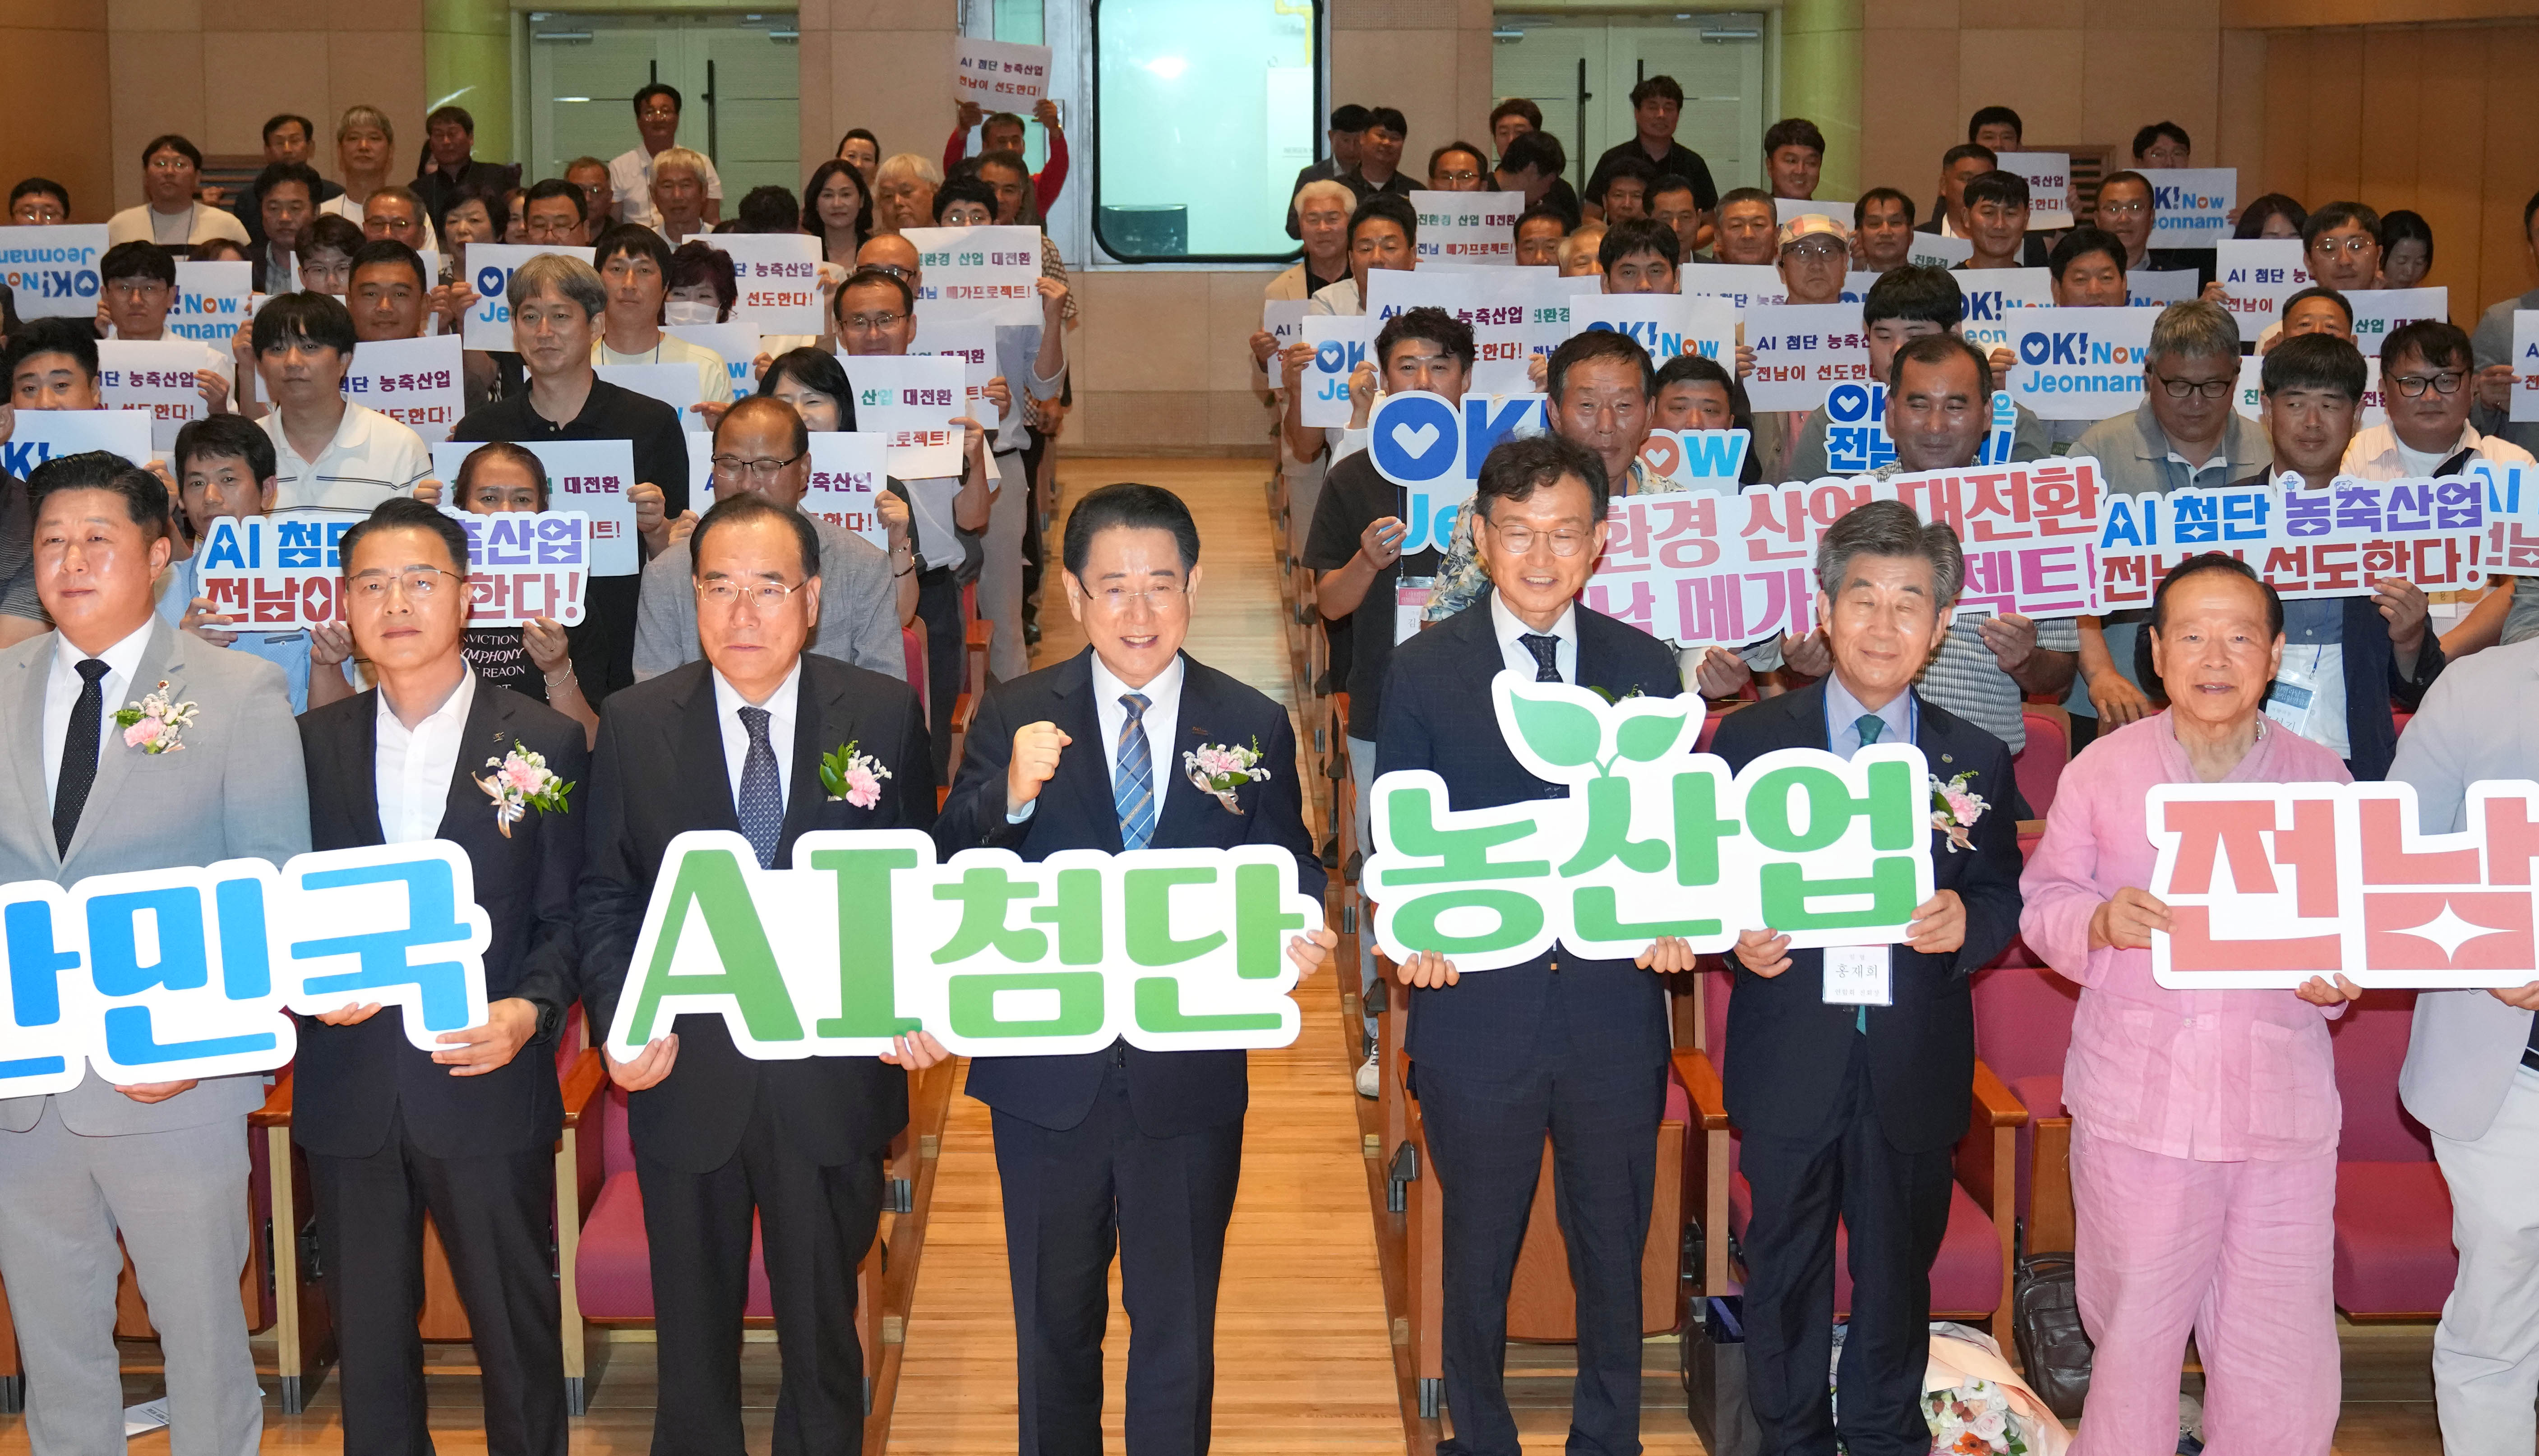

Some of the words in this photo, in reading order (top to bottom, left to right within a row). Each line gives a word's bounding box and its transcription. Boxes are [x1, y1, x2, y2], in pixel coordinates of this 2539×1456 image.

[960, 57, 972, 67] AI
[2182, 193, 2224, 209] Now
[1459, 215, 1479, 226] 산업
[1418, 243, 1439, 255] 전남
[958, 253, 983, 266] 산업
[992, 252, 1031, 266] 대전환
[756, 263, 812, 277] 농축산업
[2228, 269, 2246, 282] AI
[2255, 268, 2284, 283] 첨단
[43, 270, 99, 297] OK!
[185, 294, 237, 313] Now
[747, 291, 813, 306] 선도한다!
[2227, 298, 2273, 313] 전남이
[1275, 324, 1291, 336] AI
[2355, 319, 2384, 333] 산업
[1662, 333, 1719, 359] Now
[1757, 336, 1777, 350] AI
[1787, 335, 1818, 350] 첨단
[2020, 332, 2088, 365] OK!
[129, 371, 194, 387] 농축산업
[379, 370, 450, 392] 농축산업
[1756, 366, 1805, 382] 전남이
[861, 389, 893, 405] 산업
[903, 389, 952, 405] 대전환
[564, 476, 620, 494] 대전환
[1896, 466, 2100, 543] 대전환
[2101, 500, 2157, 548] AI
[2174, 493, 2270, 544] 첨단
[2285, 482, 2482, 537] 농축산업
[205, 524, 259, 569] AI
[2263, 535, 2481, 591] 선도한다!
[1381, 760, 1917, 954] 농산업
[2164, 797, 2539, 972] 전남
